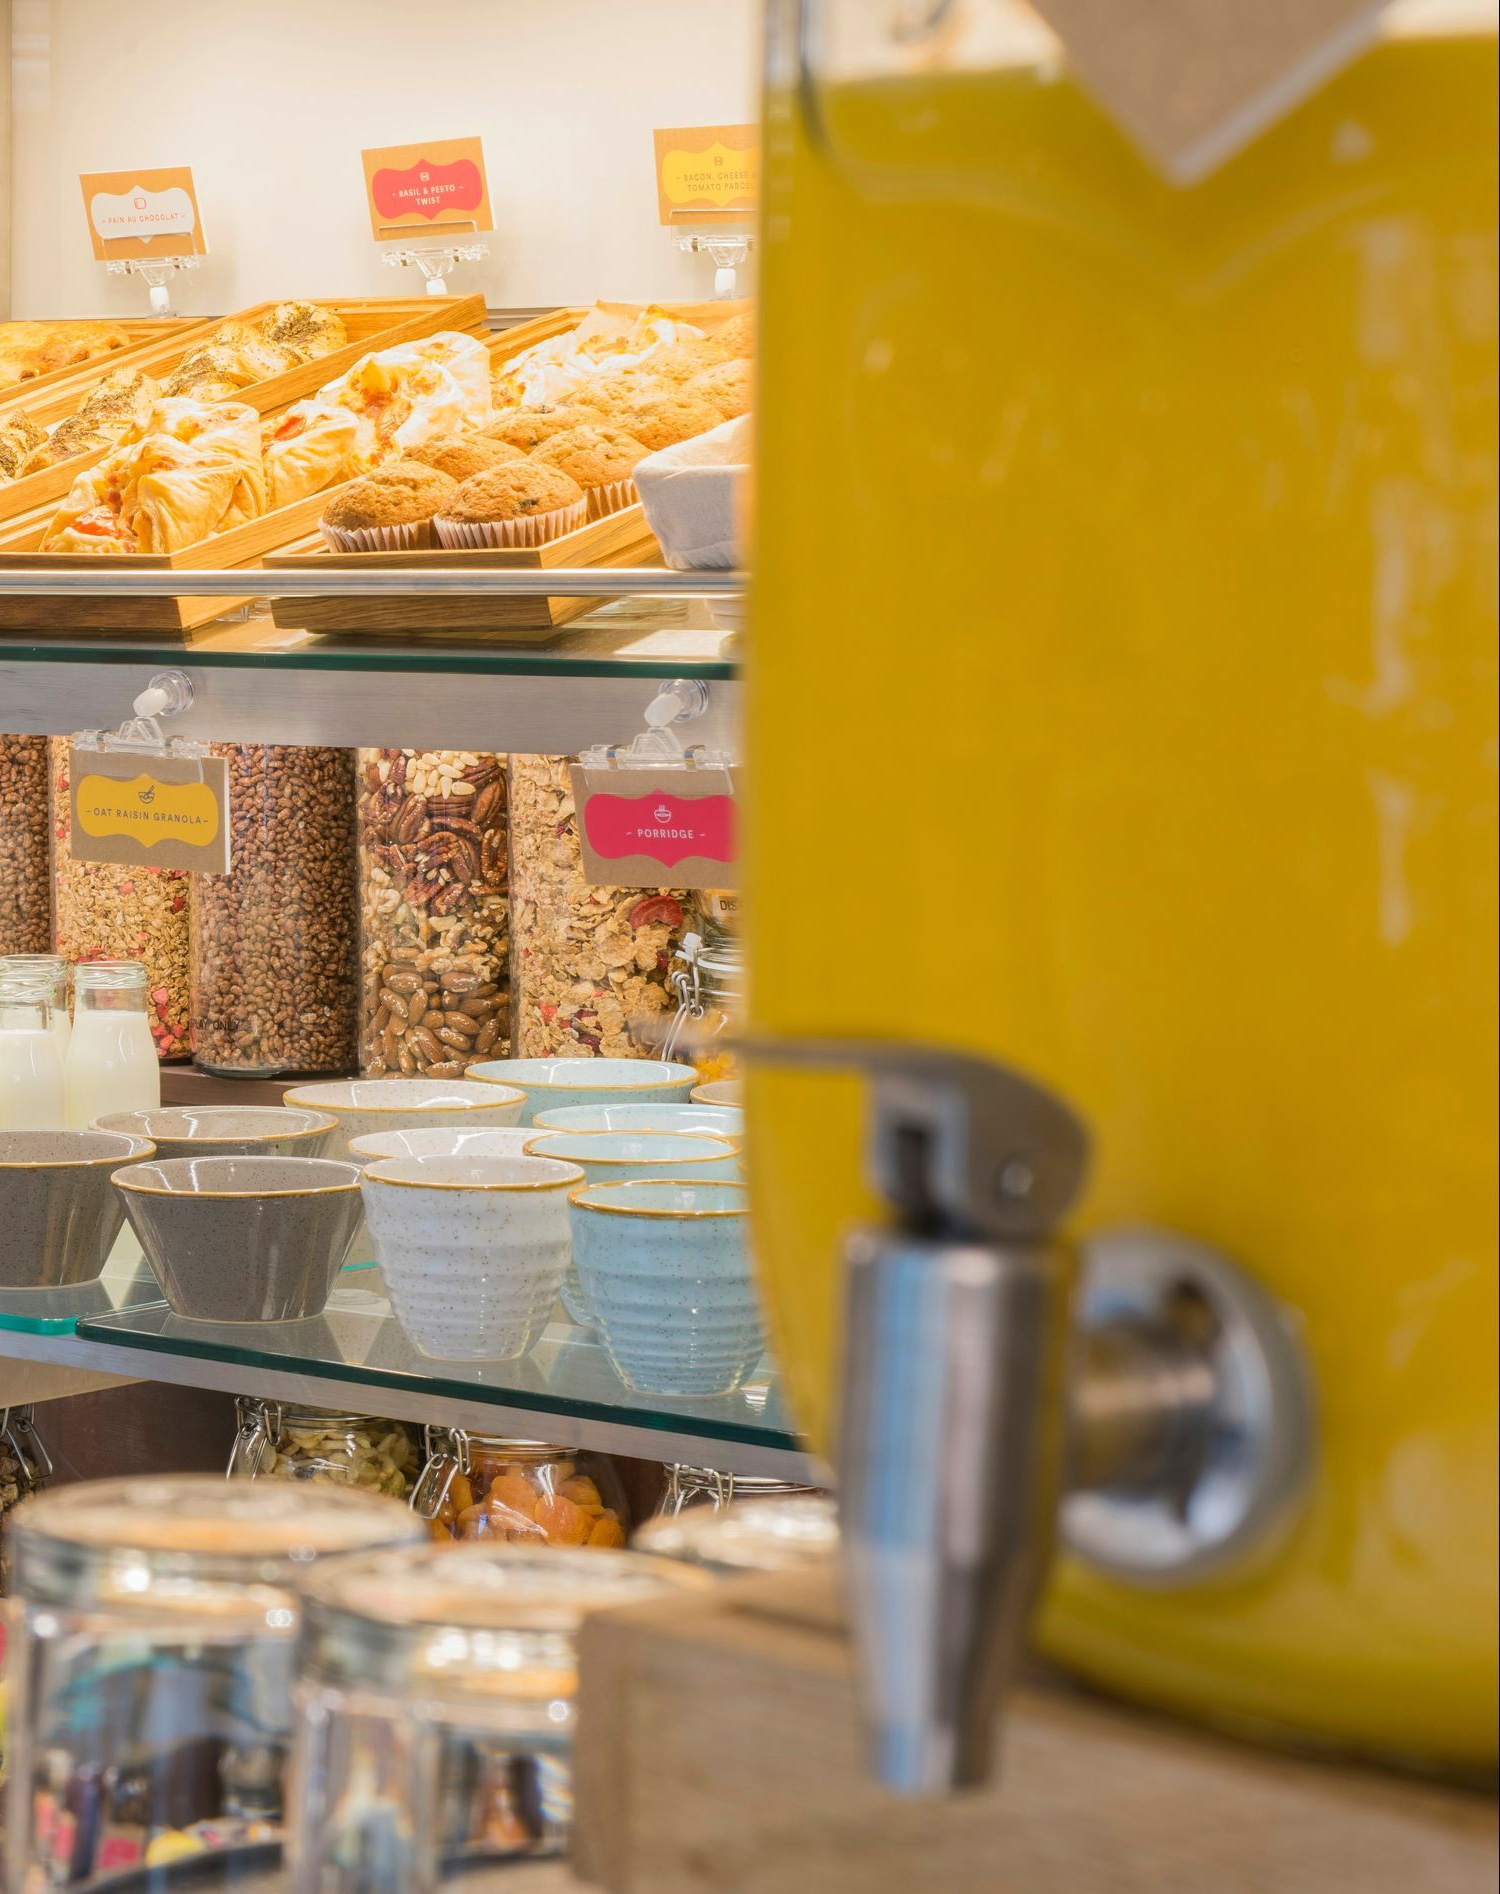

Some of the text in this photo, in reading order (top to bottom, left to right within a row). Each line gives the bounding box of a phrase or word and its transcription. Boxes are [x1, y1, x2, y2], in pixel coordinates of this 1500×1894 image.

[398, 184, 456, 198] BASIL & PESTO
[687, 184, 721, 192] TOMATO
[416, 196, 441, 206] TWIST
[128, 215, 137, 223] AU
[139, 213, 179, 222] CHOCOLAT
[93, 807, 202, 825] OAT RAISIN GRANOLA
[637, 828, 695, 839] PORRIDGE
